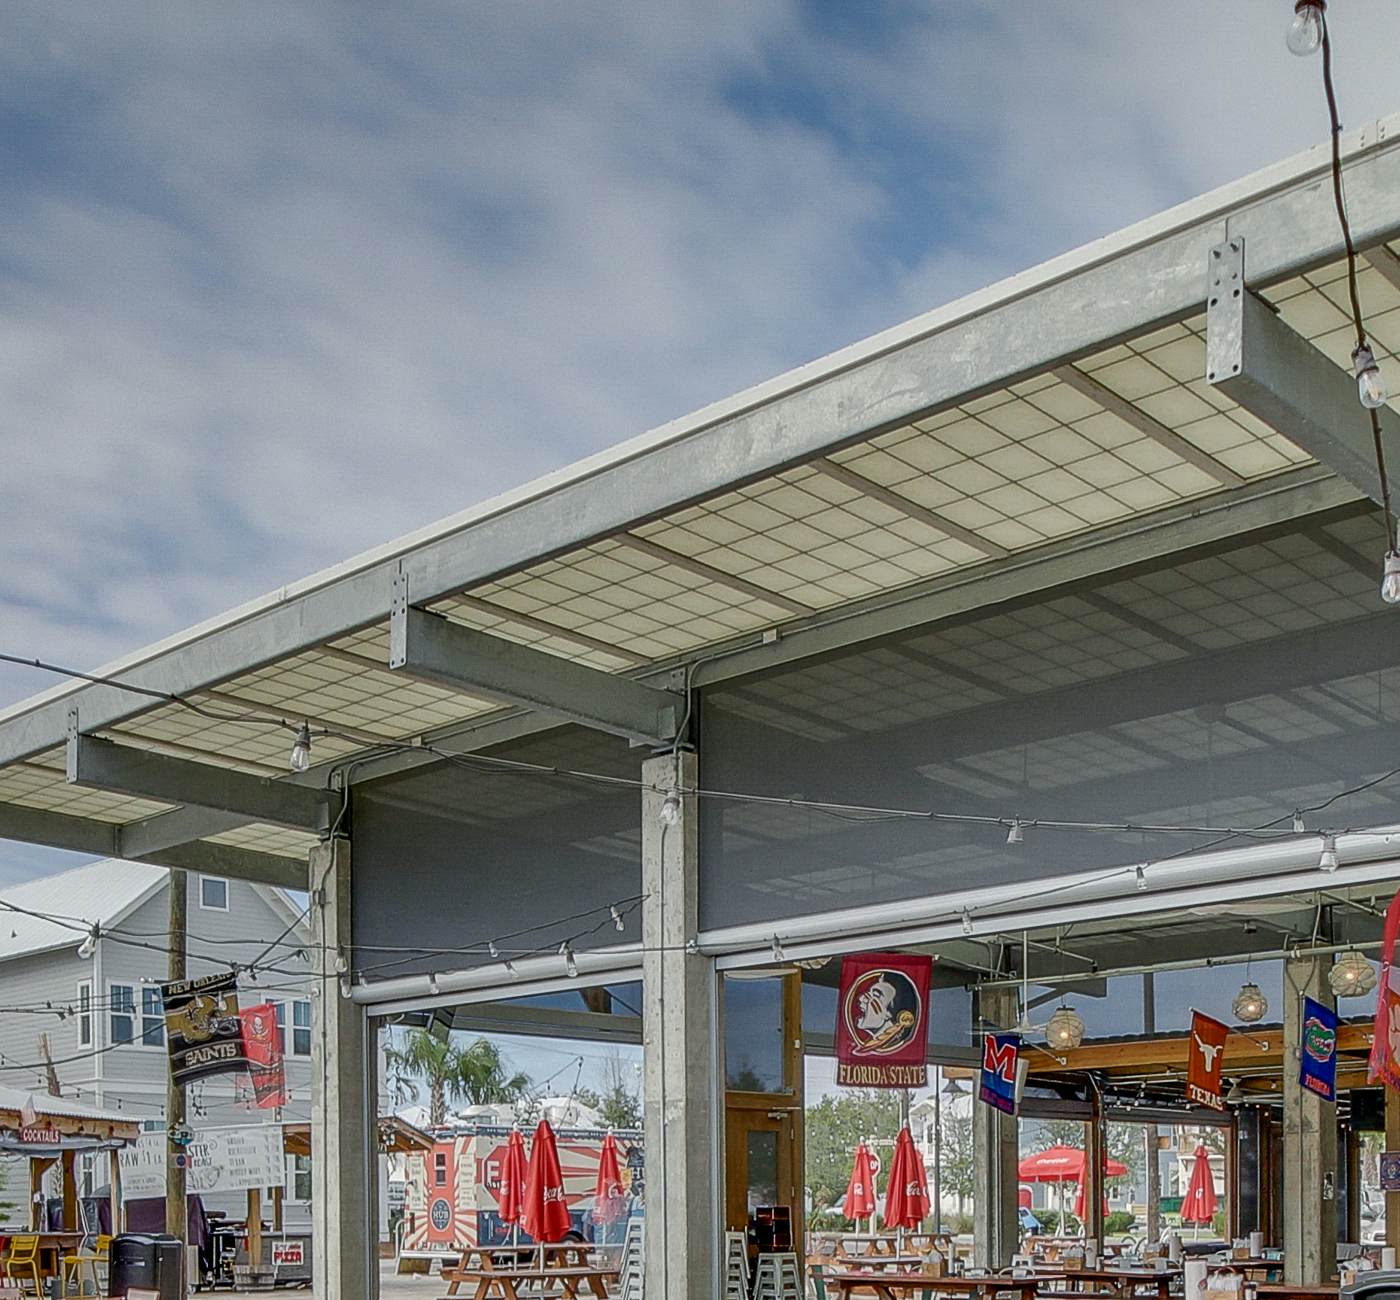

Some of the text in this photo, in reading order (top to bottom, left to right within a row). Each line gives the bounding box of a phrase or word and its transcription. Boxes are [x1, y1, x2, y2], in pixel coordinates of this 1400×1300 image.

[168, 981, 191, 995] NEW
[185, 1043, 236, 1066] SAINTS
[983, 1034, 1016, 1083] M
[840, 1064, 926, 1084] FLORIDA STATE
[23, 1129, 59, 1142] COCKTAILS
[187, 1144, 209, 1158] STER
[119, 1151, 139, 1168] RAW
[433, 1210, 449, 1220] HUB
